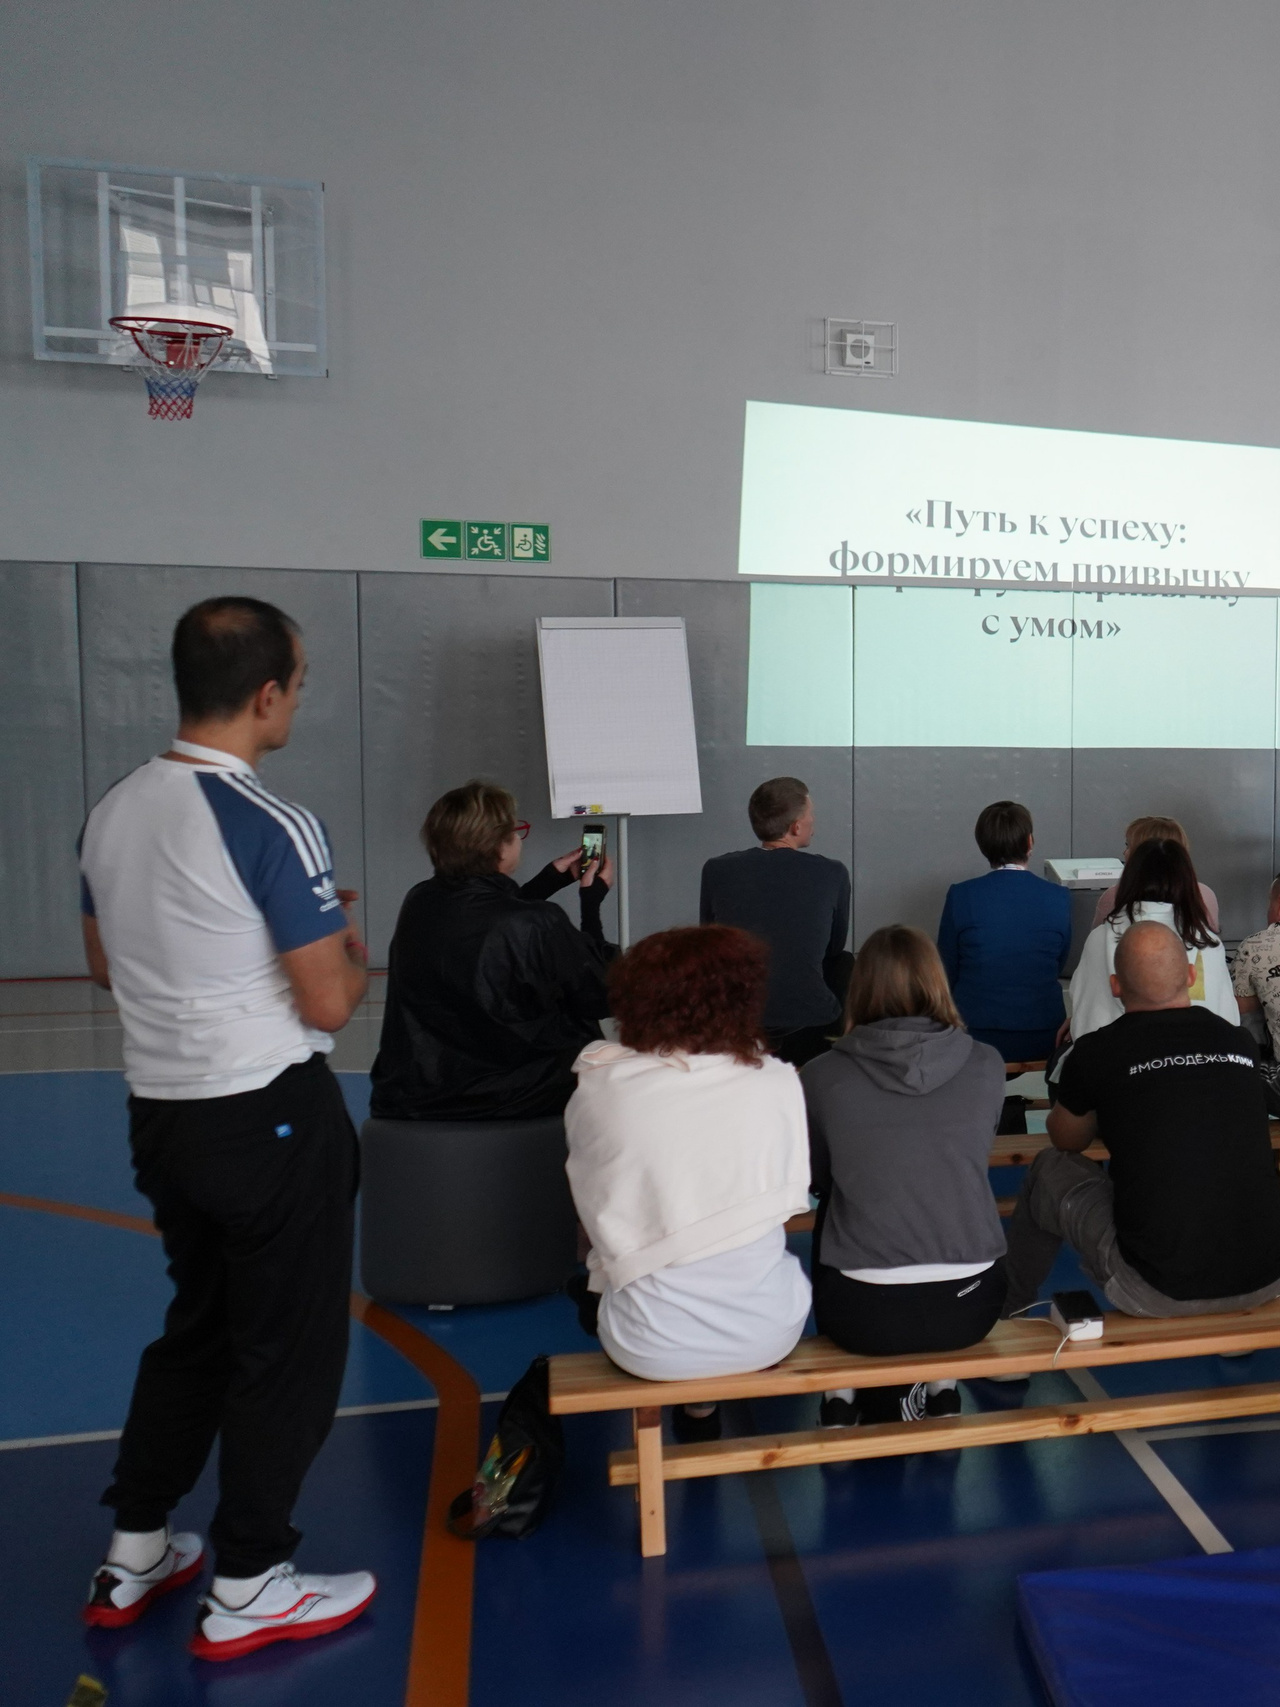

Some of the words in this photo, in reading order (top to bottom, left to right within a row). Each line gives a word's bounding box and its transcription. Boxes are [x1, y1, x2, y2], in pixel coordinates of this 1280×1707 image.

[905, 499, 1018, 537] «Путь
[1028, 511, 1050, 536] к
[1058, 514, 1187, 549] успеху:
[829, 540, 1060, 597] формируем
[1072, 561, 1251, 606] привычку
[981, 612, 1000, 635] с
[1009, 615, 1122, 643] умом»
